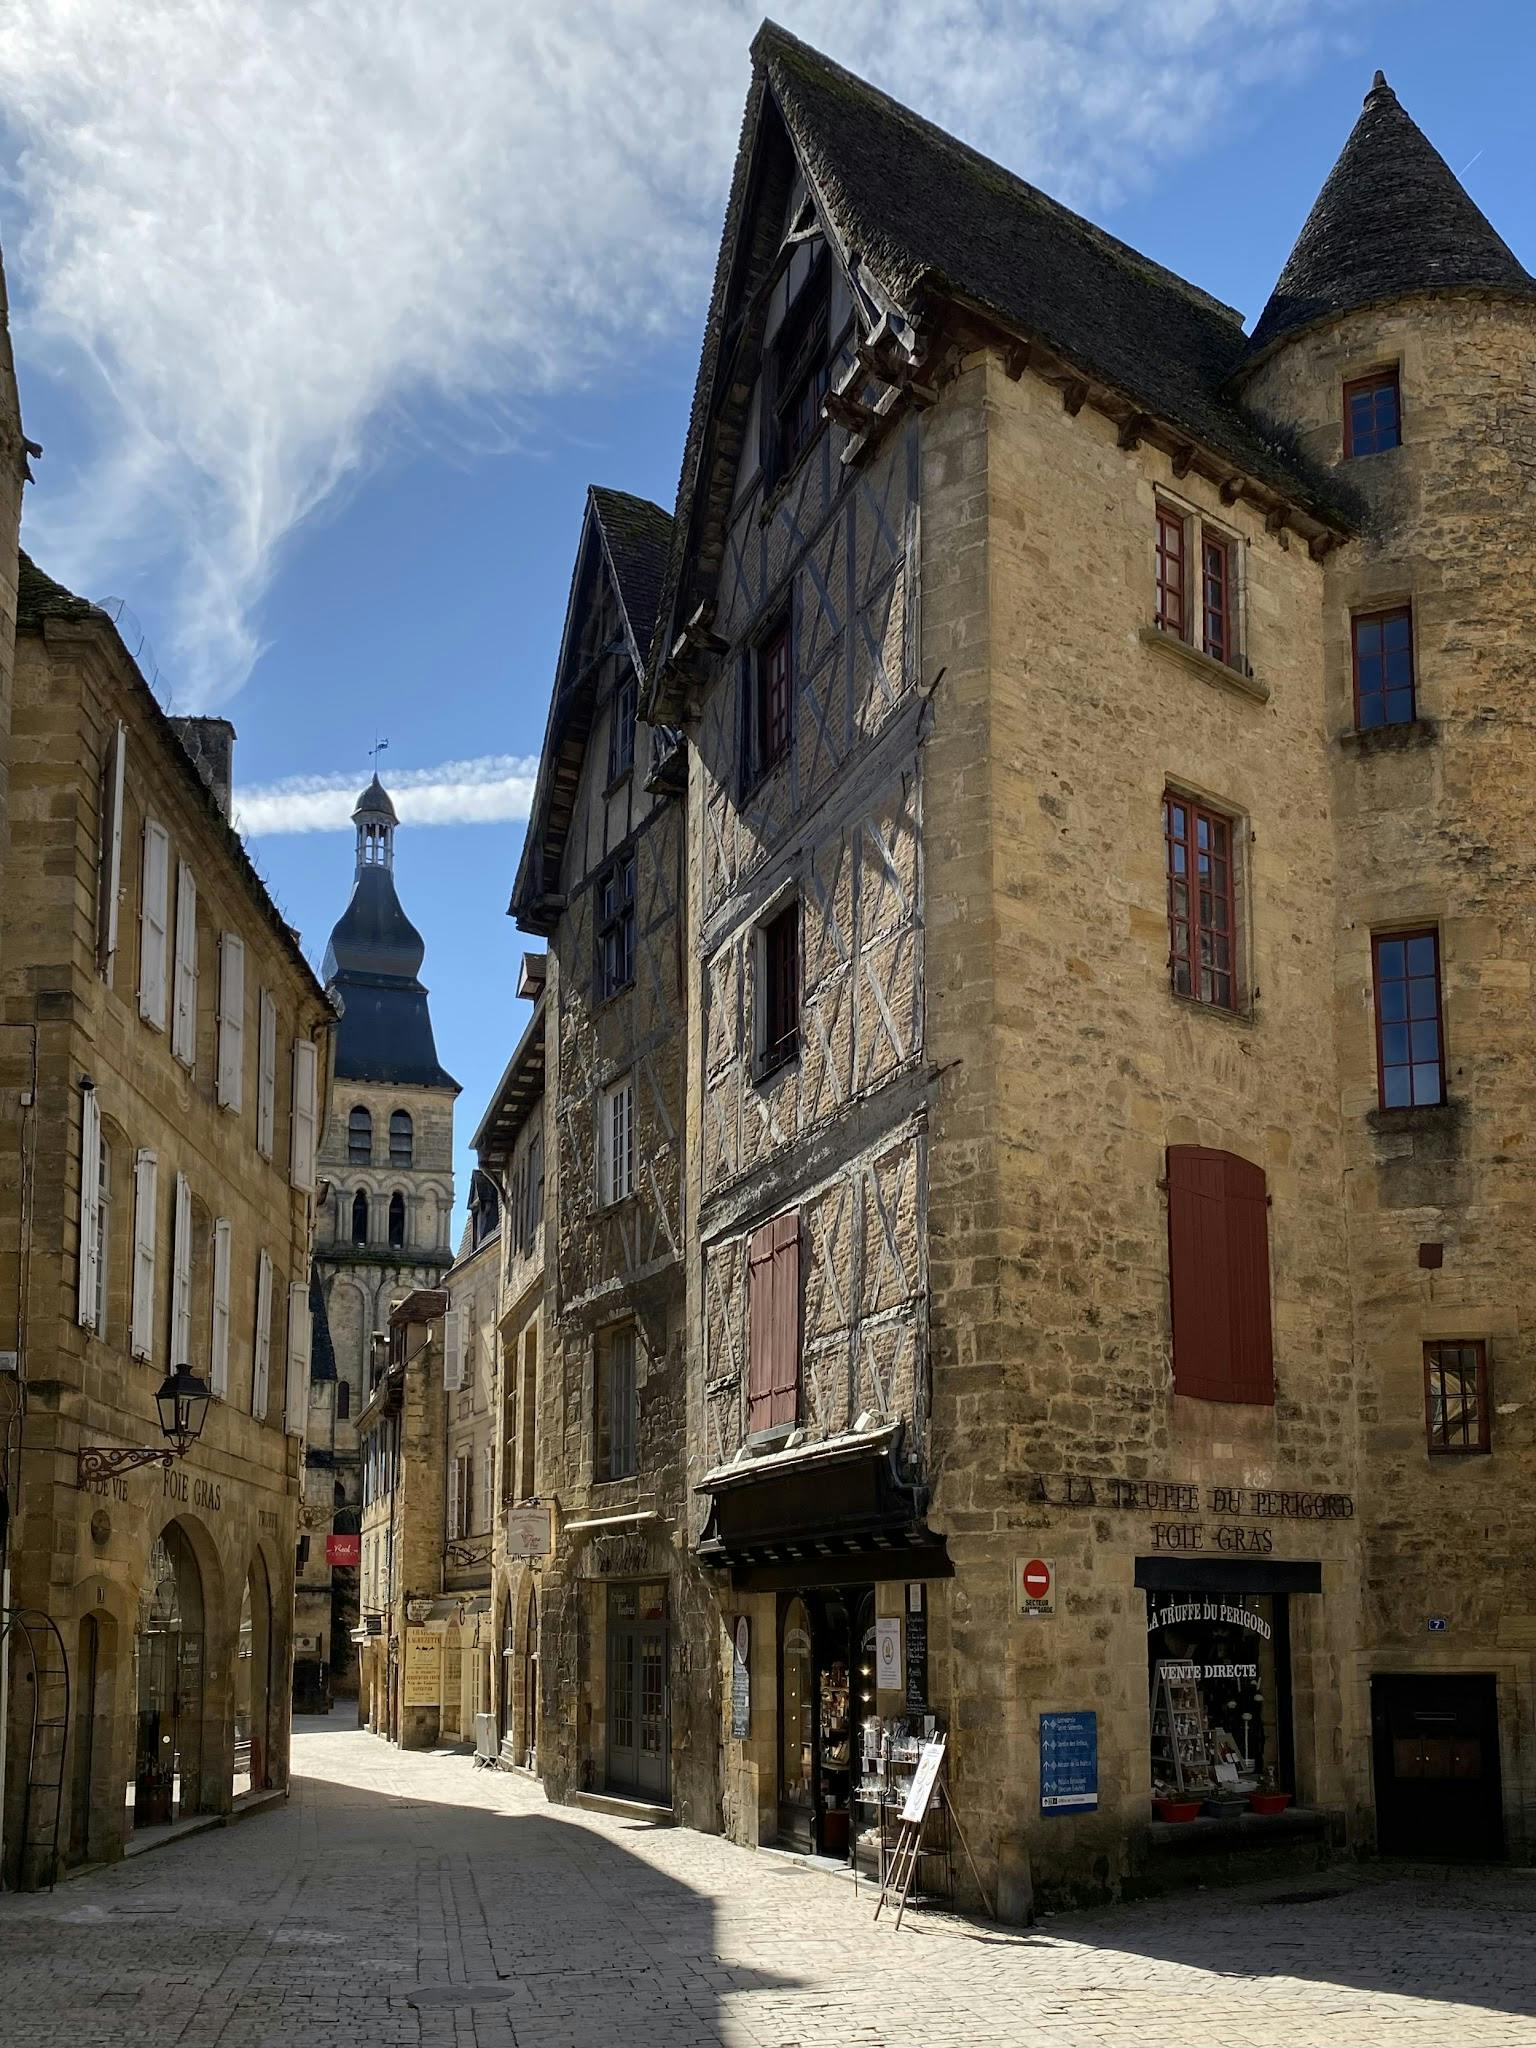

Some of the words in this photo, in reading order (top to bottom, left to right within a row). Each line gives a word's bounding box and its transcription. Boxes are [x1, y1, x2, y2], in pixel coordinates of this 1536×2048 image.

[112, 1478, 128, 1501] VIE
[163, 1469, 189, 1502] FOIE
[194, 1479, 221, 1511] GRAS
[1063, 1476, 1098, 1503] LA
[1112, 1479, 1200, 1511] TRUFFE
[1212, 1488, 1241, 1515] DU
[1255, 1491, 1354, 1518] PERIGORD
[1152, 1523, 1204, 1550] FOIE
[1216, 1526, 1273, 1552] GRAS
[1160, 1603, 1201, 1626] TRUFFE
[1203, 1604, 1218, 1620] DU
[1220, 1605, 1271, 1640] PERIGORD
[1433, 1621, 1440, 1629] 7
[1160, 1665, 1201, 1680] VENTE
[1204, 1664, 1257, 1678] DIRECTE
